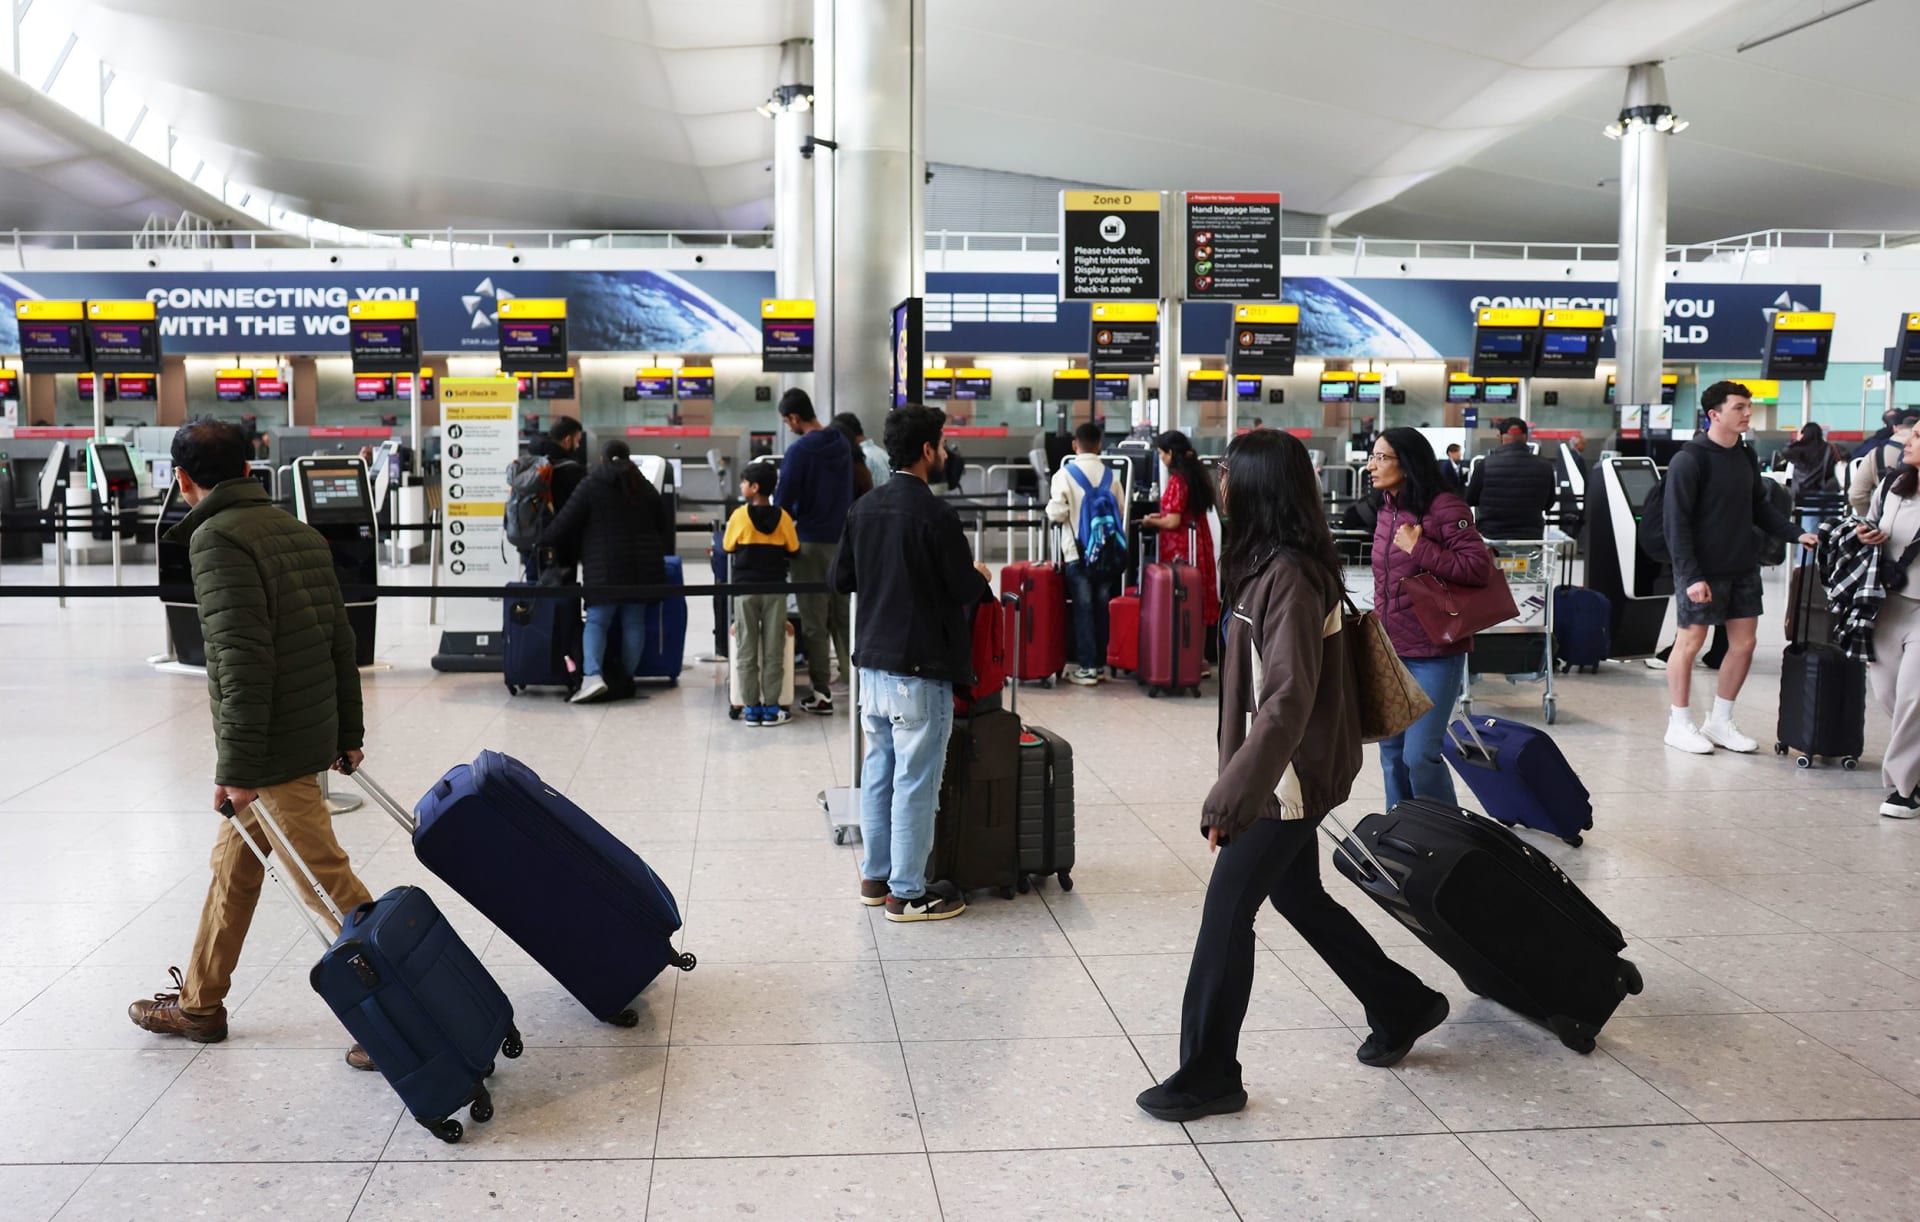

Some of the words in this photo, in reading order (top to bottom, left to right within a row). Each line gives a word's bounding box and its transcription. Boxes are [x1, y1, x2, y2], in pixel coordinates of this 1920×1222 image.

[1093, 196, 1120, 205] Zone
[1124, 196, 1131, 204] D
[1214, 206, 1247, 215] baggage
[1074, 256, 1098, 266] Flight
[1074, 266, 1105, 275] Display
[146, 288, 348, 308] CONNECTING
[356, 288, 419, 301] YOU
[1470, 296, 1619, 316] CONNECTI
[1664, 299, 1715, 318] YOU
[235, 316, 296, 335] THE
